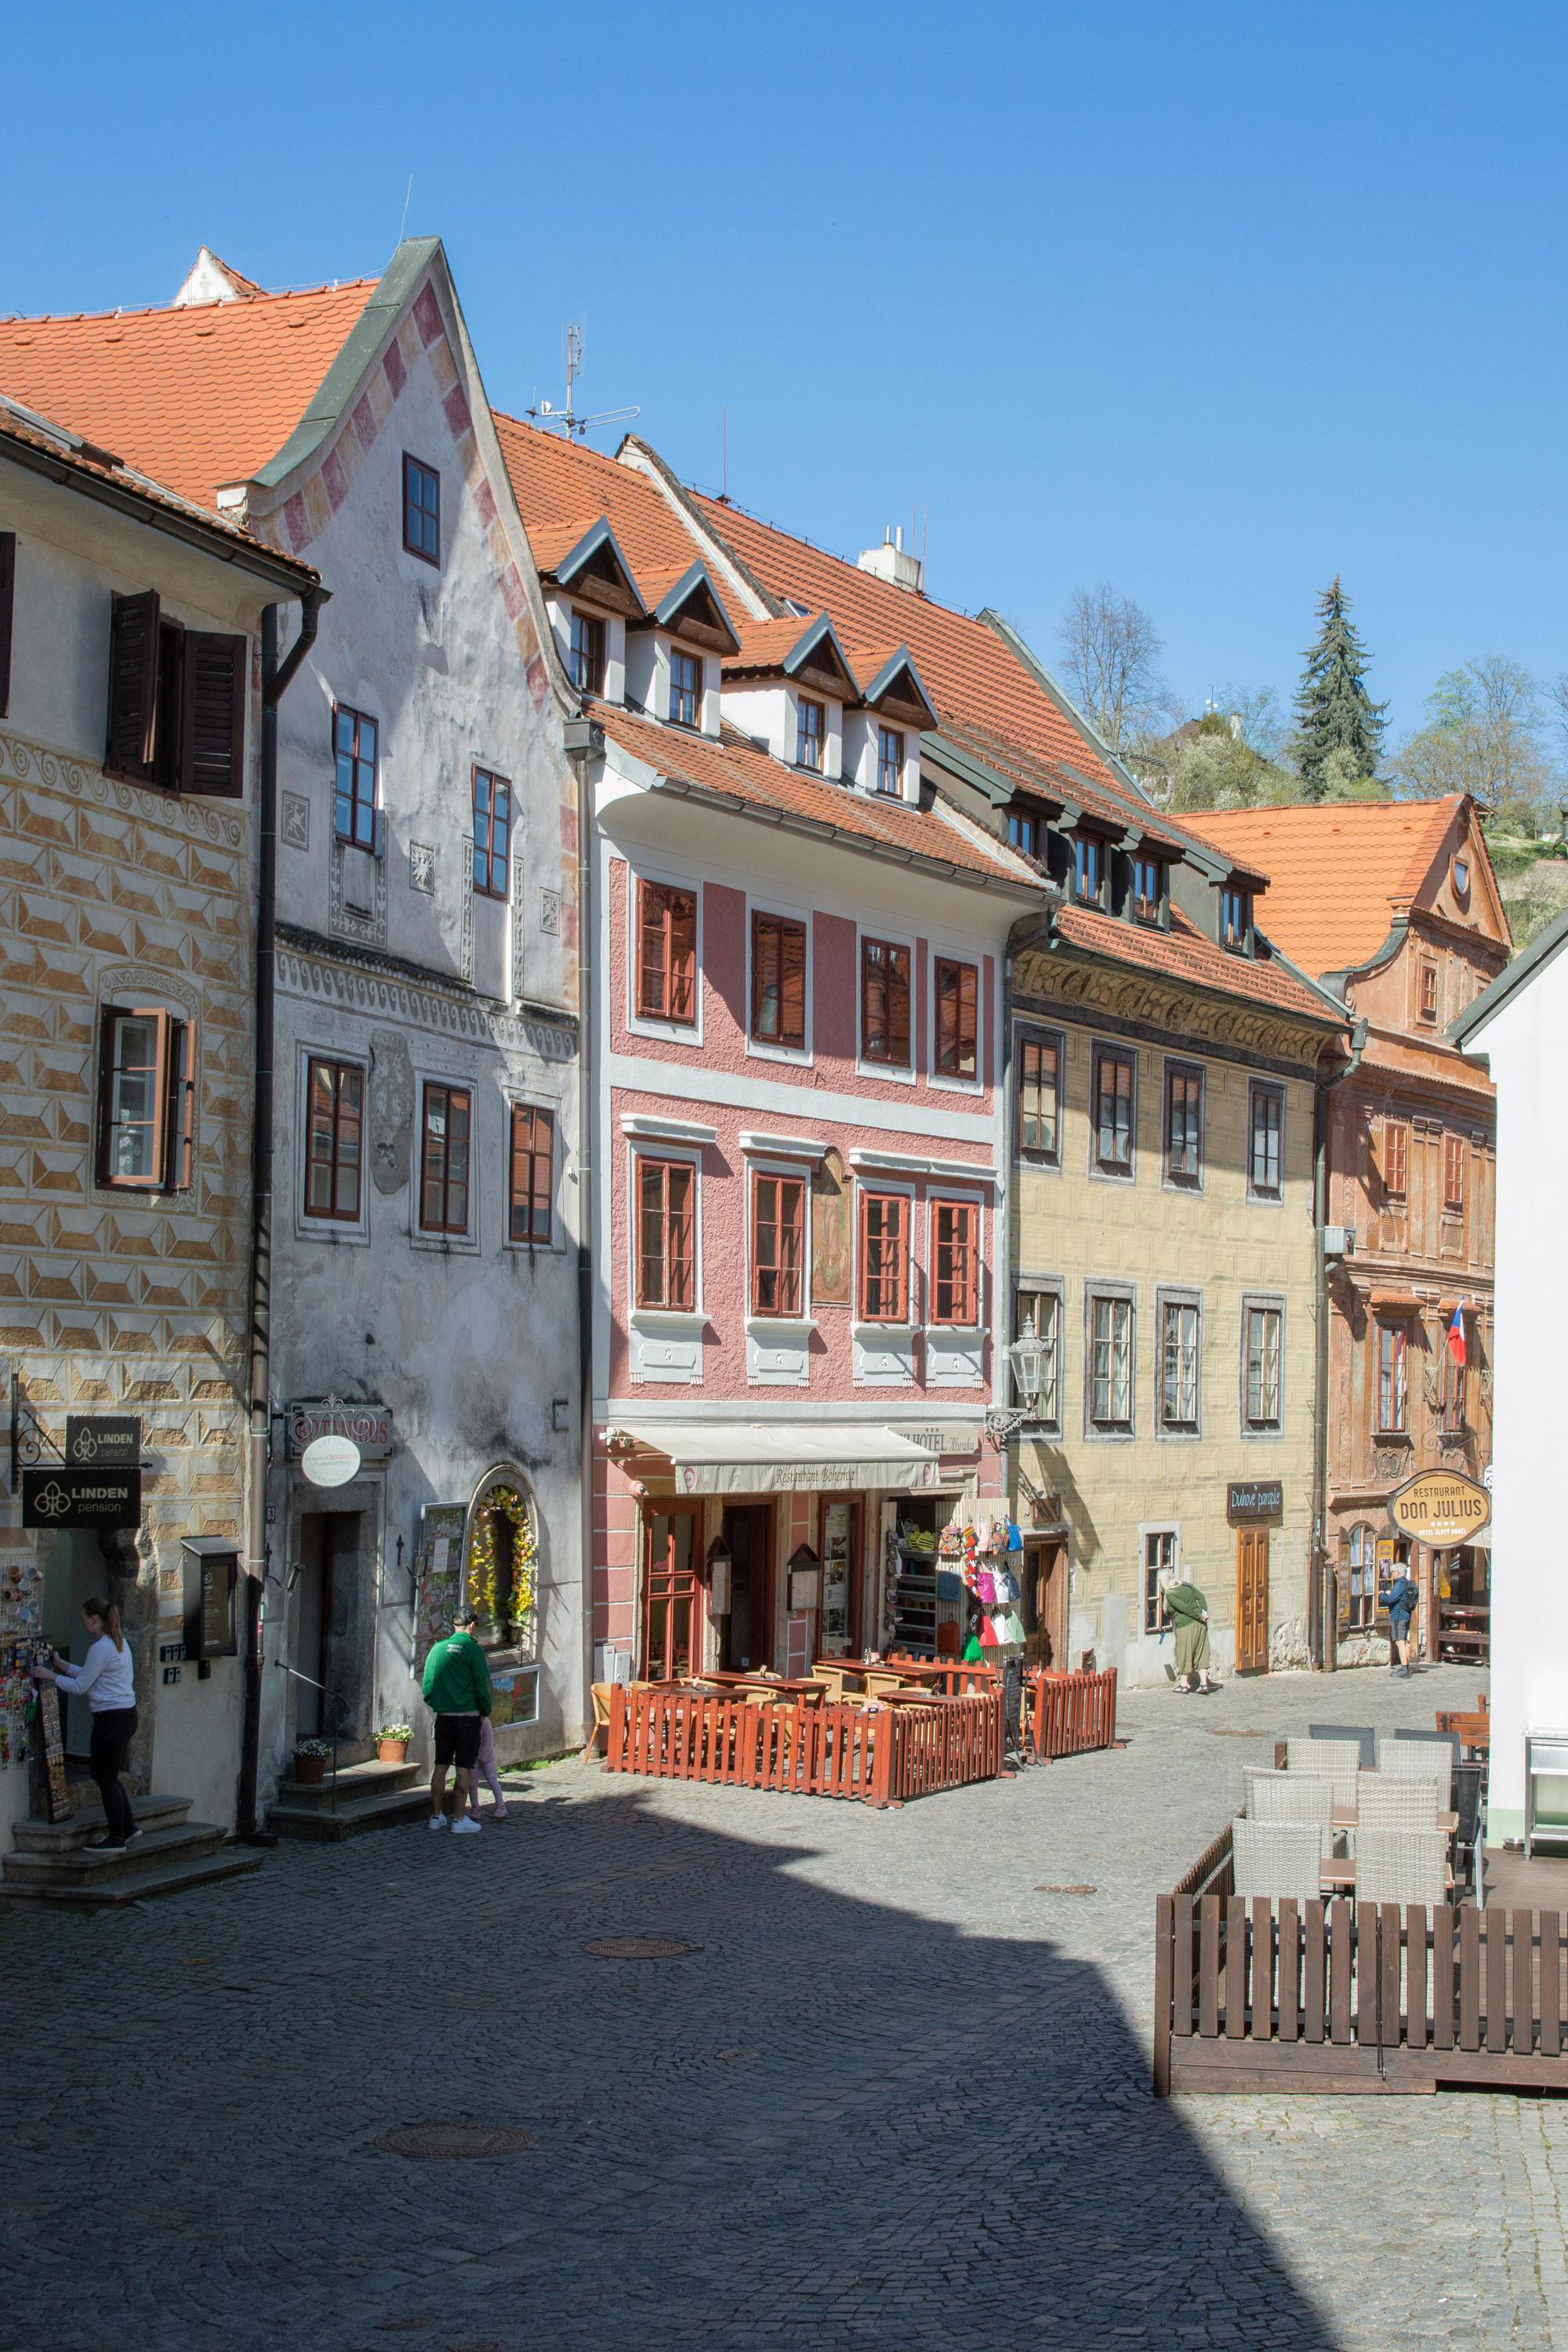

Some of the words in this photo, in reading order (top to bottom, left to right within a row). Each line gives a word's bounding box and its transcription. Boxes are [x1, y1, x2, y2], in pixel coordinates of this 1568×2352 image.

[298, 1419, 389, 1444] BOTANICUS
[97, 1433, 133, 1444] LINDEN
[913, 1434, 947, 1450] HOTEL
[100, 1447, 129, 1457] pension
[776, 1468, 818, 1486] Restaurant
[822, 1466, 855, 1484] Bohemia
[71, 1487, 129, 1499] LINDEN
[1414, 1486, 1465, 1498] RESTAURANT
[78, 1501, 122, 1514] pension
[1400, 1501, 1428, 1519] DON
[1433, 1499, 1482, 1519] JULIUS
